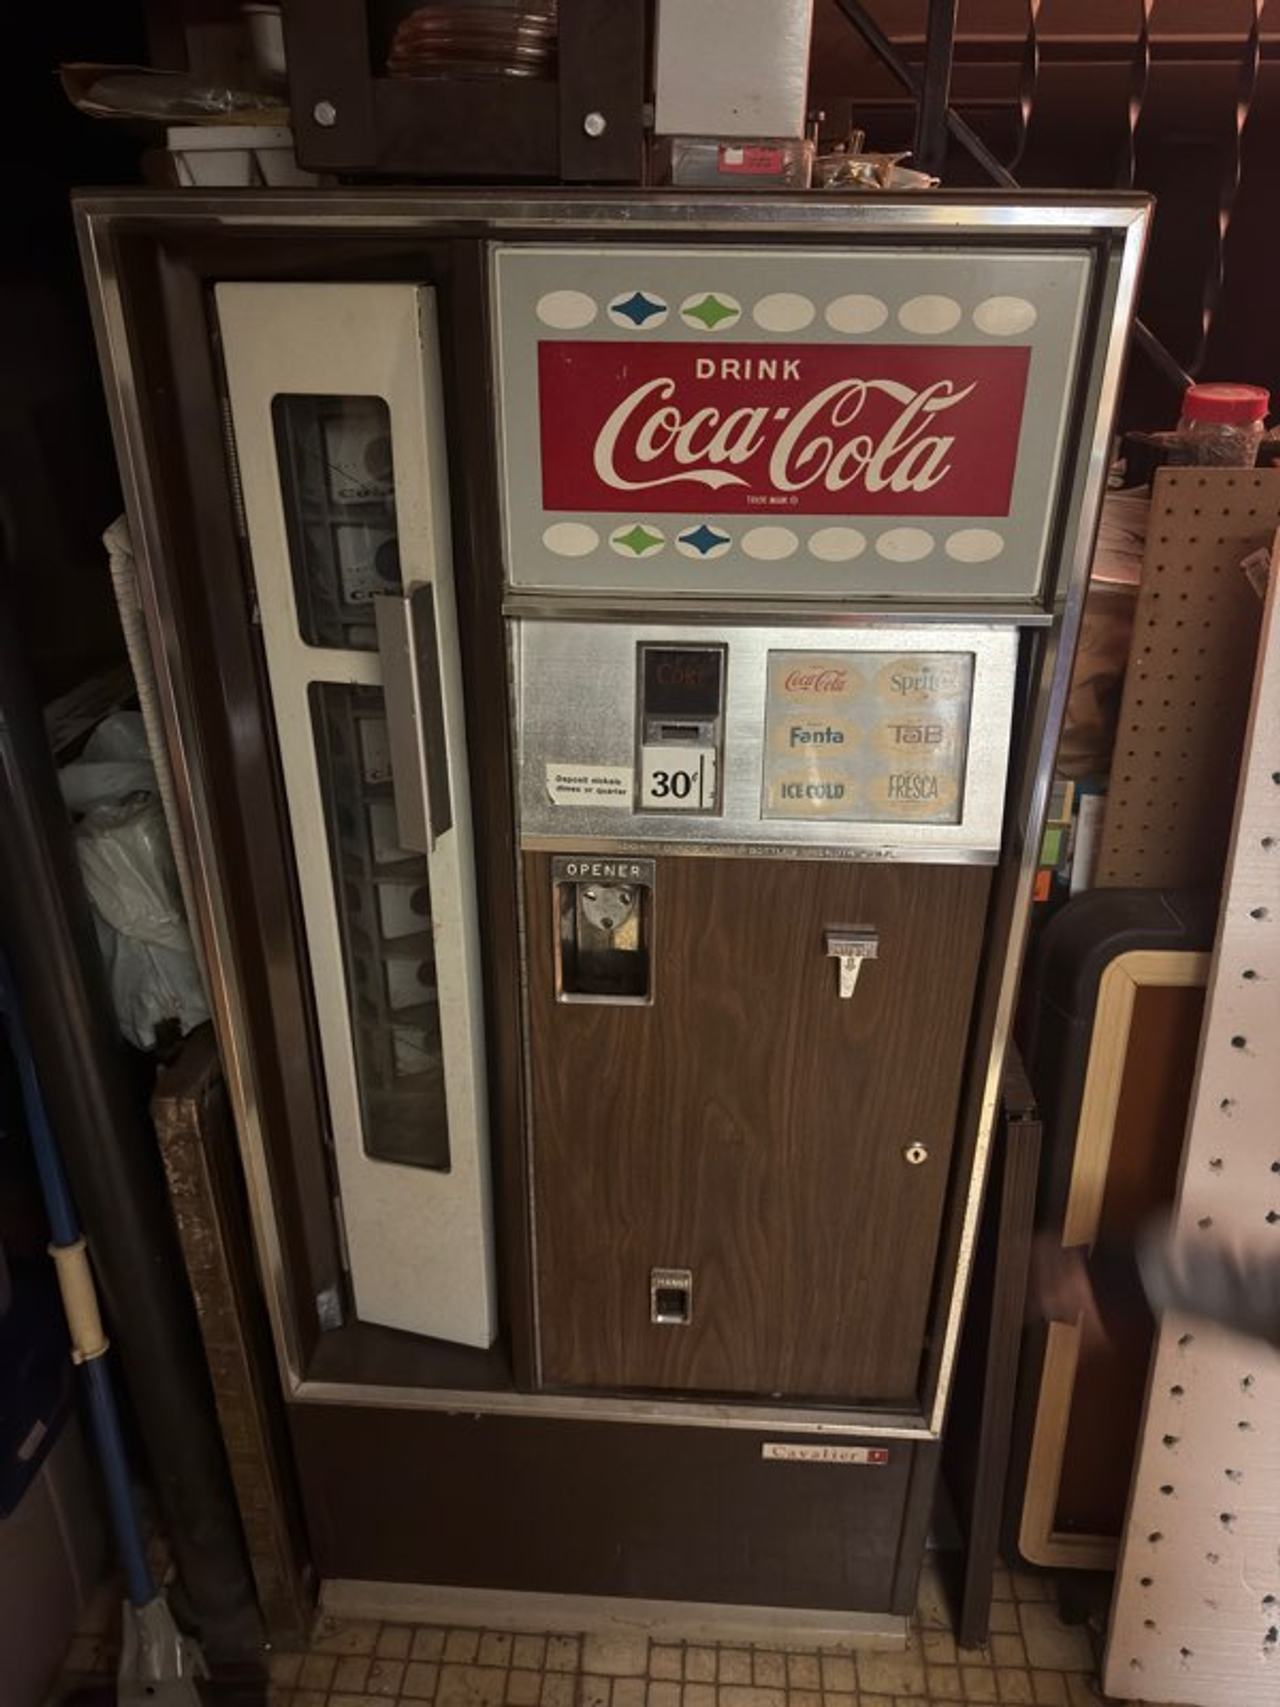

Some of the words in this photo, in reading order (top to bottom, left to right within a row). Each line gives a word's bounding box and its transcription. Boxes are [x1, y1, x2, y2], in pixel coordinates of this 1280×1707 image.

[695, 358, 802, 381] DRINK
[593, 377, 978, 492] Coca-Cola
[785, 666, 848, 692] Coca-Cola
[790, 727, 844, 748] Fanta
[782, 782, 804, 799] ICE
[806, 782, 845, 799] COLD
[567, 864, 640, 878] OPENER
[771, 1446, 858, 1461] Cavalier
